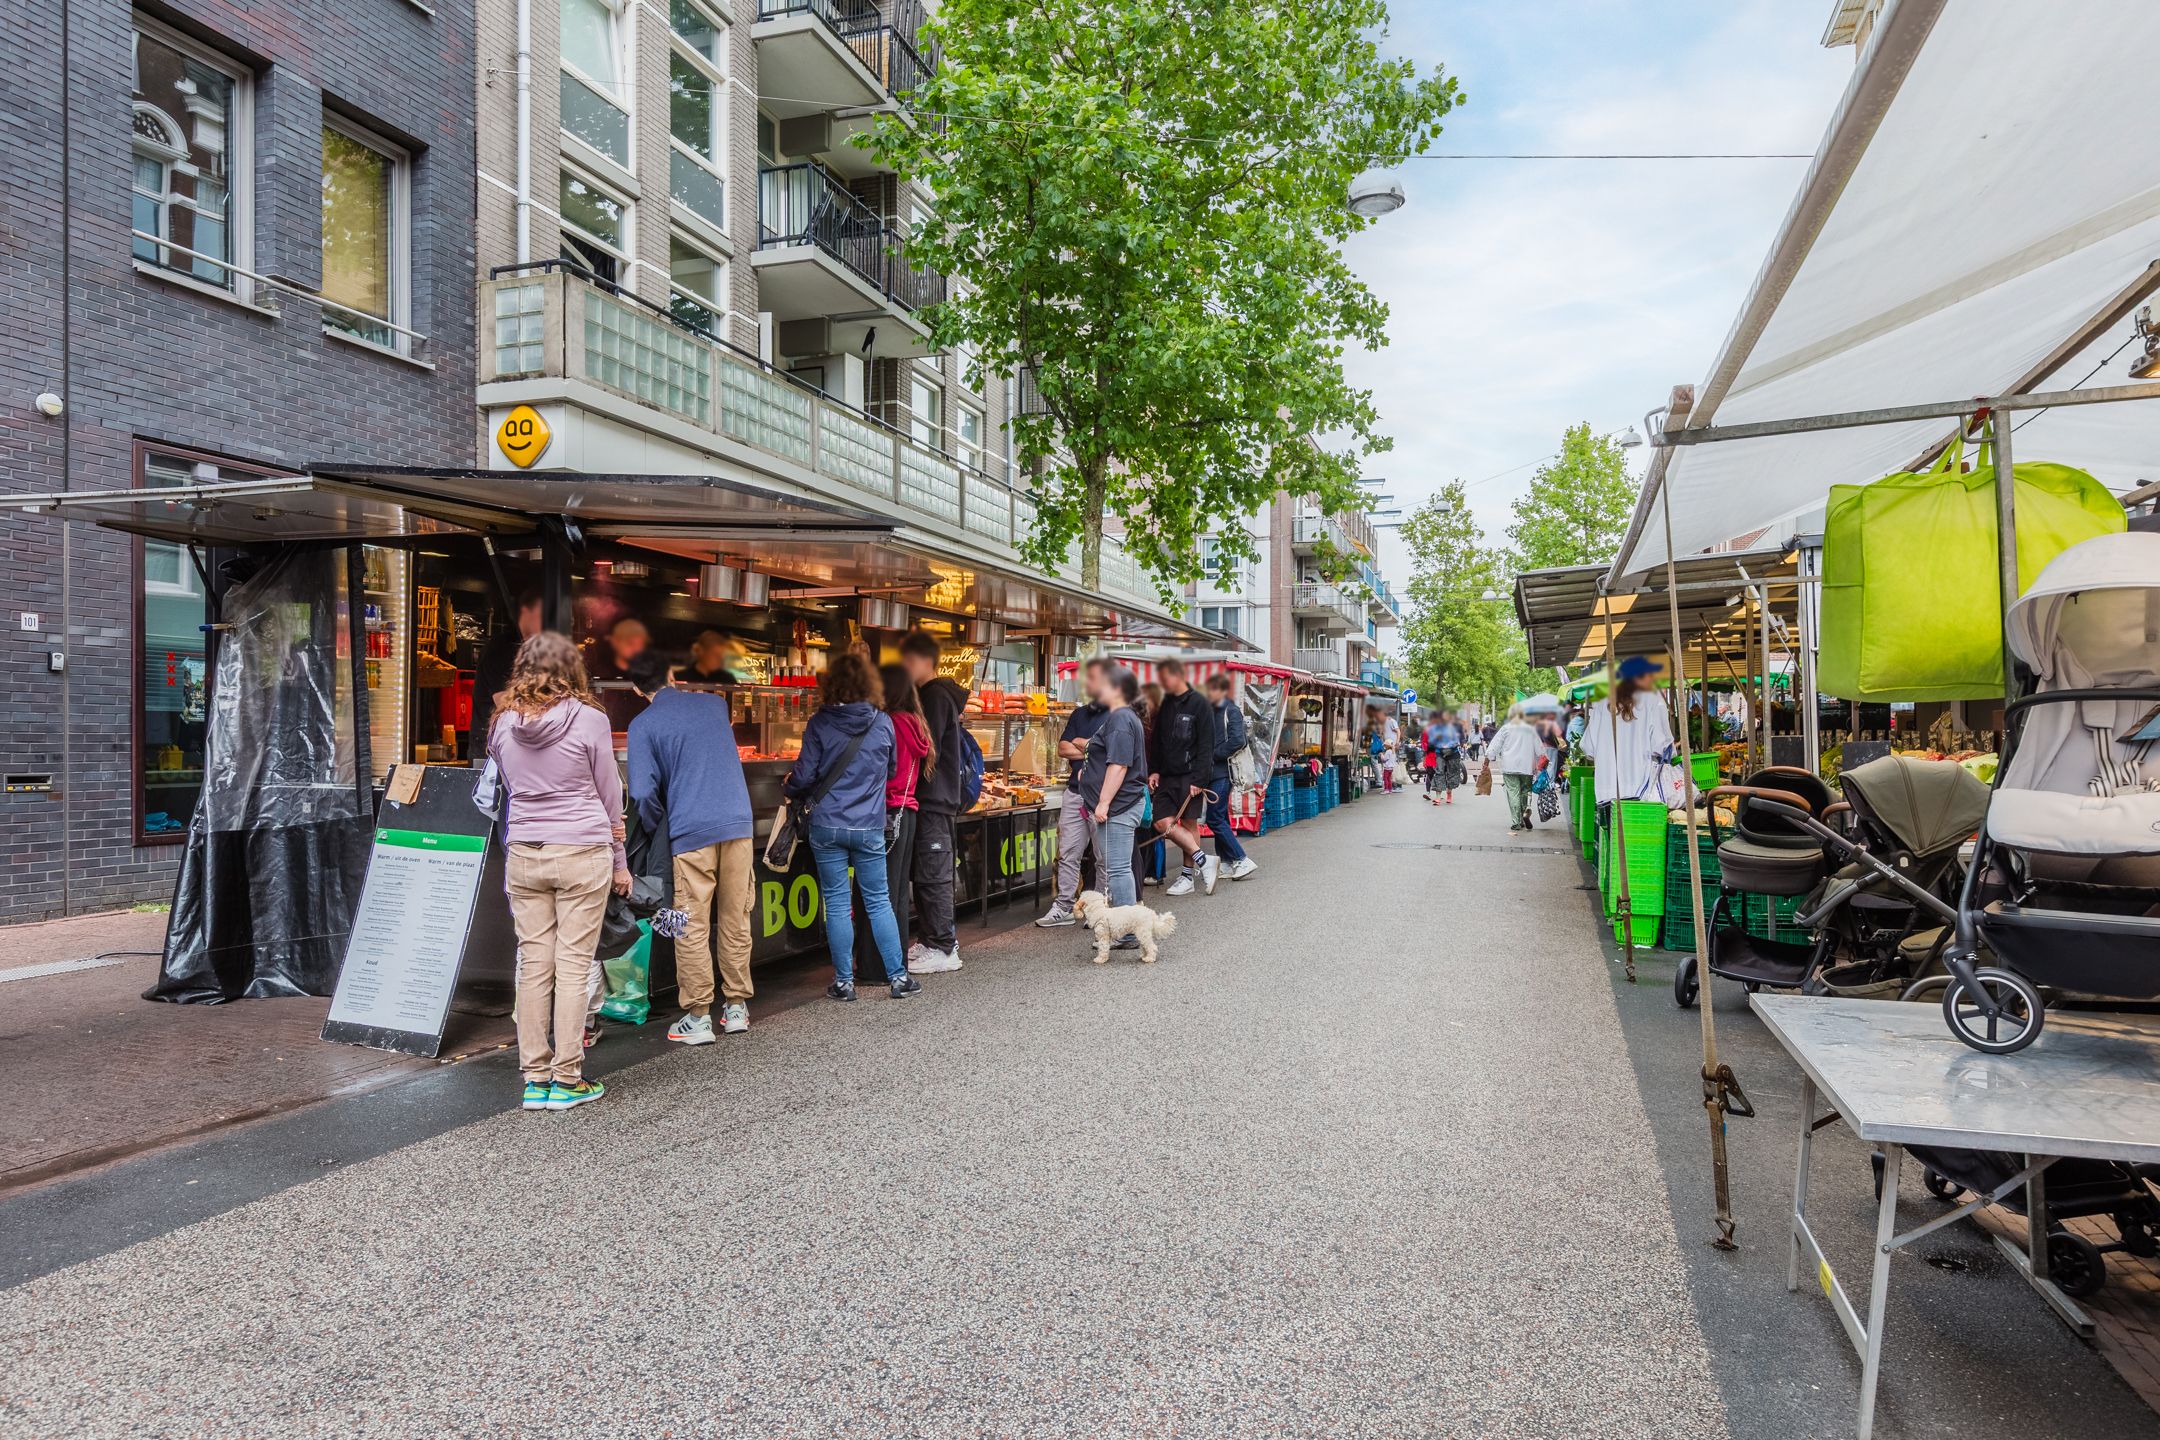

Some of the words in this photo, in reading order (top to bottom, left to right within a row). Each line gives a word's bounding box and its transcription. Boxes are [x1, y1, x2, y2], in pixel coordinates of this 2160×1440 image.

[24, 617, 36, 627] 101
[940, 648, 980, 663] oralles
[938, 663, 961, 676] wat
[422, 837, 438, 845] Menu
